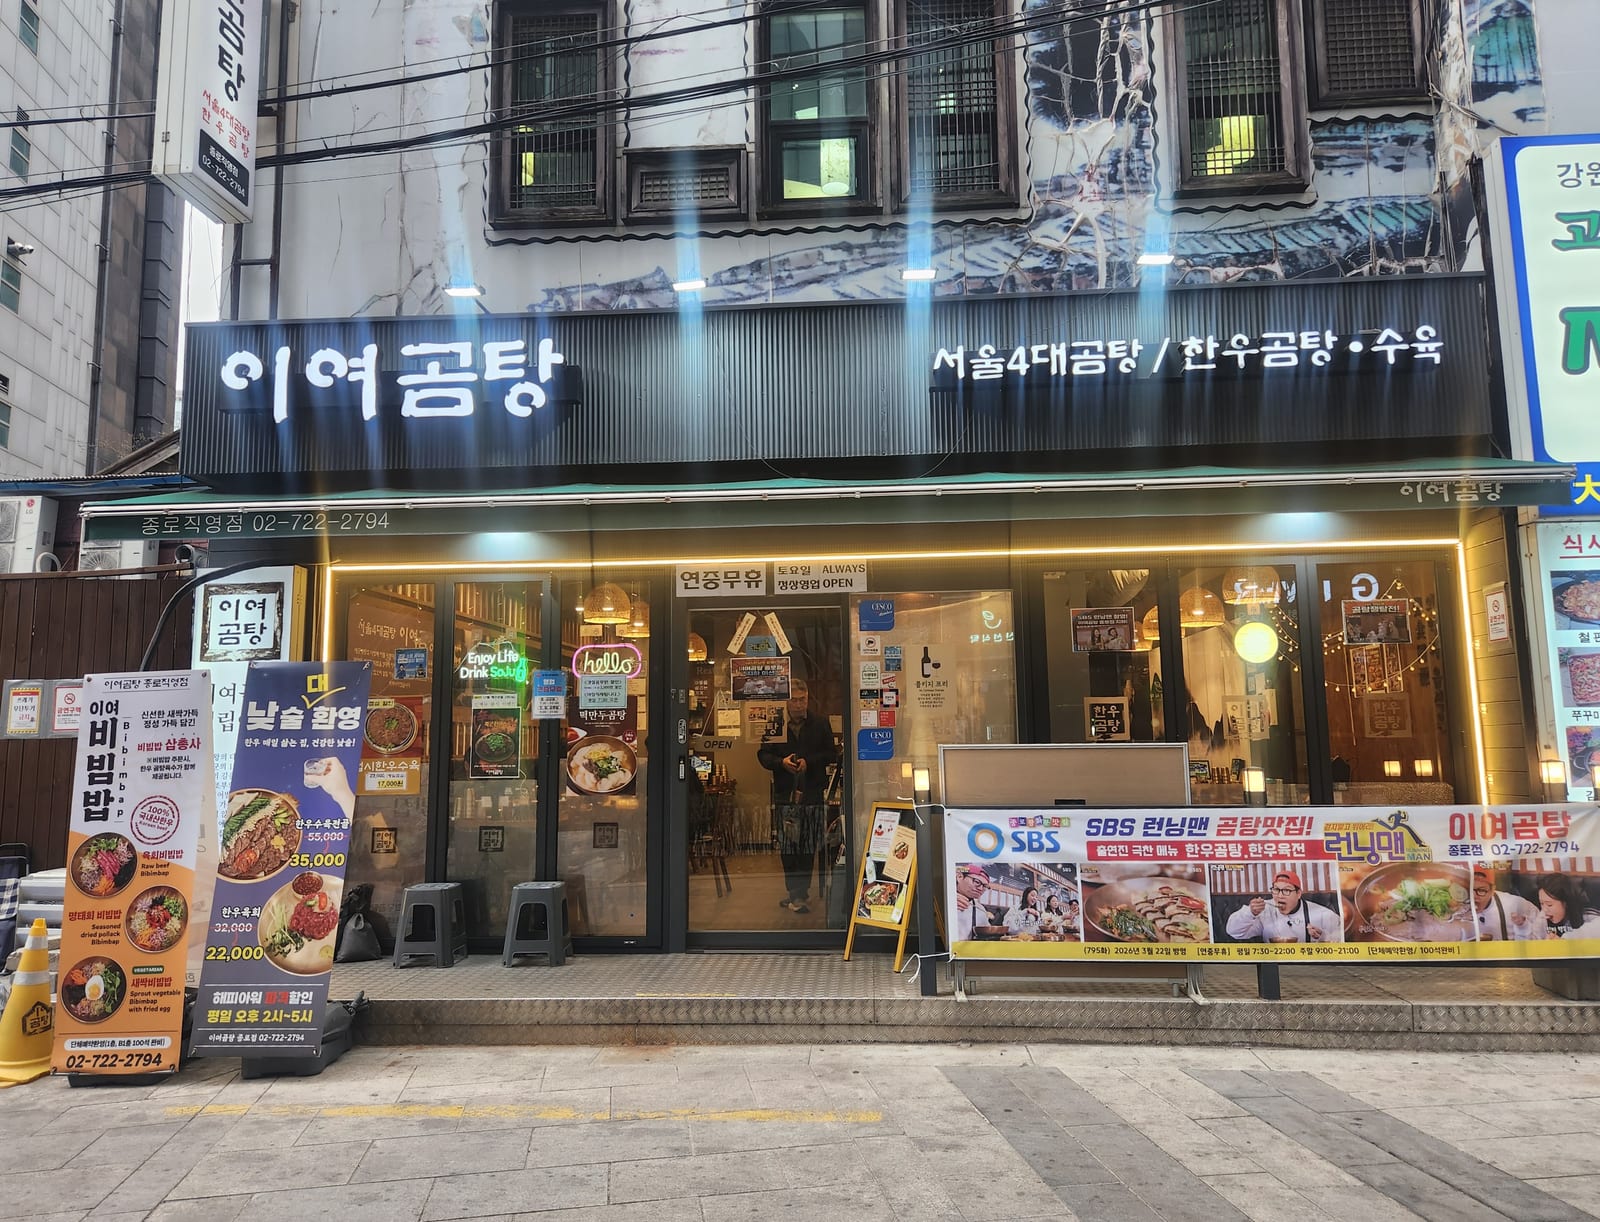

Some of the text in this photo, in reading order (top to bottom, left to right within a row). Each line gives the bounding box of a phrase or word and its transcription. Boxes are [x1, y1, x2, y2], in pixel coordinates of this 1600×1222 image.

[202, 89, 250, 142] 서울4대곰탕
[202, 155, 245, 197] 02-722-2794
[933, 338, 1142, 380] 서울4대곰탕
[220, 337, 565, 424] 이여곰탕
[1400, 482, 1504, 503] 이여곰탕
[141, 511, 390, 536] 종로직영점 02-722-2794
[778, 563, 866, 576] 토요일 ALWAYS
[680, 569, 763, 590] 연중무휴
[778, 578, 853, 590] 정상영업 OPEN
[219, 598, 267, 621] 이여
[871, 603, 892, 611] CESCO
[217, 622, 268, 646] 곰탕
[468, 649, 519, 665] Enjoy Life
[584, 652, 632, 674] hello
[459, 665, 488, 678] Drink
[105, 677, 189, 690] 이여곰탕 종로직영점
[307, 673, 329, 693] 대
[89, 700, 119, 716] 이여
[142, 709, 199, 719] 신선한 새싹가득
[1093, 705, 1120, 718] 한우
[144, 718, 196, 728] 정성 가득 담긴
[246, 701, 362, 731] 낮술 환영
[1094, 719, 1121, 732] 곰탕
[870, 731, 892, 739] CESCO
[137, 738, 202, 751] 비빔밥 삼총사
[244, 738, 260, 747] 한우
[311, 738, 335, 747] 건강한
[703, 740, 733, 749] OPEN
[83, 717, 119, 822] 비빔밥
[117, 722, 130, 818] Bibimbap
[148, 805, 170, 817] 100%
[138, 811, 174, 827] 국내산한우
[1448, 811, 1572, 840] 이여곰탕
[1085, 816, 1315, 837] SBS 런닝맨 곰탕맛집!
[308, 832, 344, 842] 55,000
[1011, 831, 1061, 853] SBS
[142, 849, 184, 860] 육회비빔밥
[1096, 844, 1129, 857] 출연진
[1132, 844, 1154, 857] 극찬
[1157, 845, 1179, 857] 메뉴
[1324, 832, 1405, 865] 런닝맨
[1448, 841, 1580, 857] 종로점 02-722-2794
[290, 853, 346, 868] 35,000
[1407, 853, 1431, 861] MAN
[68, 910, 122, 922] 명태회 비빔밥
[222, 907, 261, 919] 한우육회
[99, 931, 121, 939] pollack
[205, 946, 265, 962] 22,000
[1083, 946, 1111, 955] (795화)
[1114, 946, 1140, 955] 2026년
[1142, 946, 1153, 955] 3월
[1155, 946, 1171, 955] 22일
[1237, 946, 1250, 955] 평일
[1300, 946, 1313, 955] 주말
[131, 977, 172, 988] 새싹비빔밥
[212, 991, 262, 1005] 해피아워
[30, 1014, 49, 1029] 곰탕
[207, 1009, 313, 1023] 평일 오후 2시~5시
[259, 1033, 305, 1042] 02-722-2794
[66, 1053, 162, 1068] 02-722-2794
